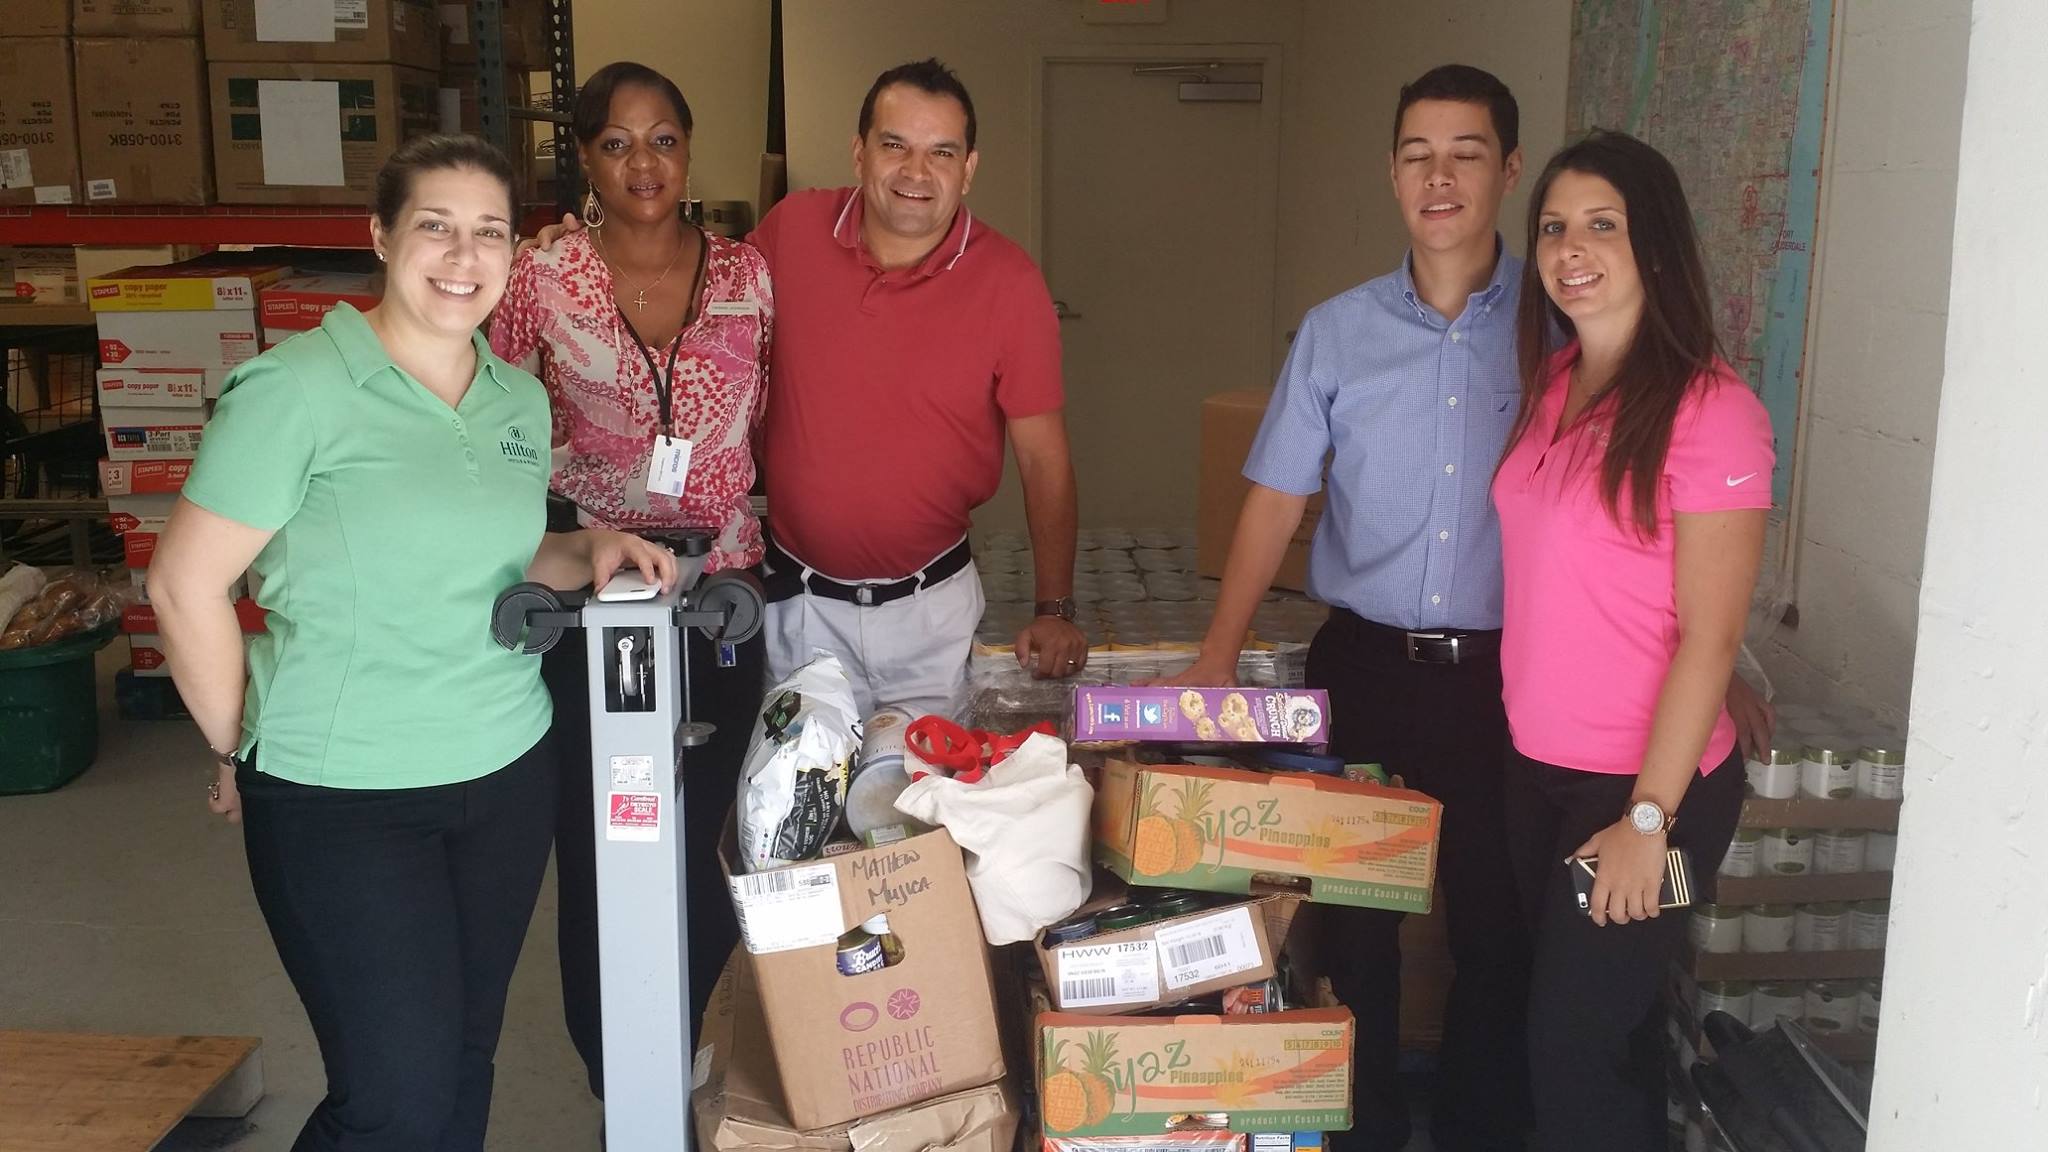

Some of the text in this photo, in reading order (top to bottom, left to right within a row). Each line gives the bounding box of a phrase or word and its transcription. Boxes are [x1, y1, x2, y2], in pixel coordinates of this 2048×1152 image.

[109, 133, 183, 147] 3100-05BK
[267, 302, 295, 311] STAPLES
[300, 303, 320, 312] copy
[127, 382, 161, 391] copy paper
[500, 441, 538, 460] Hilton
[1265, 695, 1281, 737] CRUNCH
[1205, 798, 1282, 874] yaz
[1259, 827, 1331, 849] Pineapples
[1321, 883, 1363, 896] product
[1374, 888, 1400, 900] Costa
[1403, 891, 1424, 902] Rica
[1062, 942, 1149, 959] HWW 17532
[1174, 968, 1201, 983] 17532
[842, 1025, 935, 1070] REPUBLIC
[847, 1051, 941, 1094] NATIONAL
[1114, 1039, 1192, 1123] yaz
[1169, 1069, 1245, 1085] Pineapples
[852, 1076, 944, 1113] DISTRIBUTING COMPANY
[1240, 1115, 1278, 1126] product
[1295, 1114, 1321, 1124] Costa
[1324, 1113, 1345, 1123] Rica
